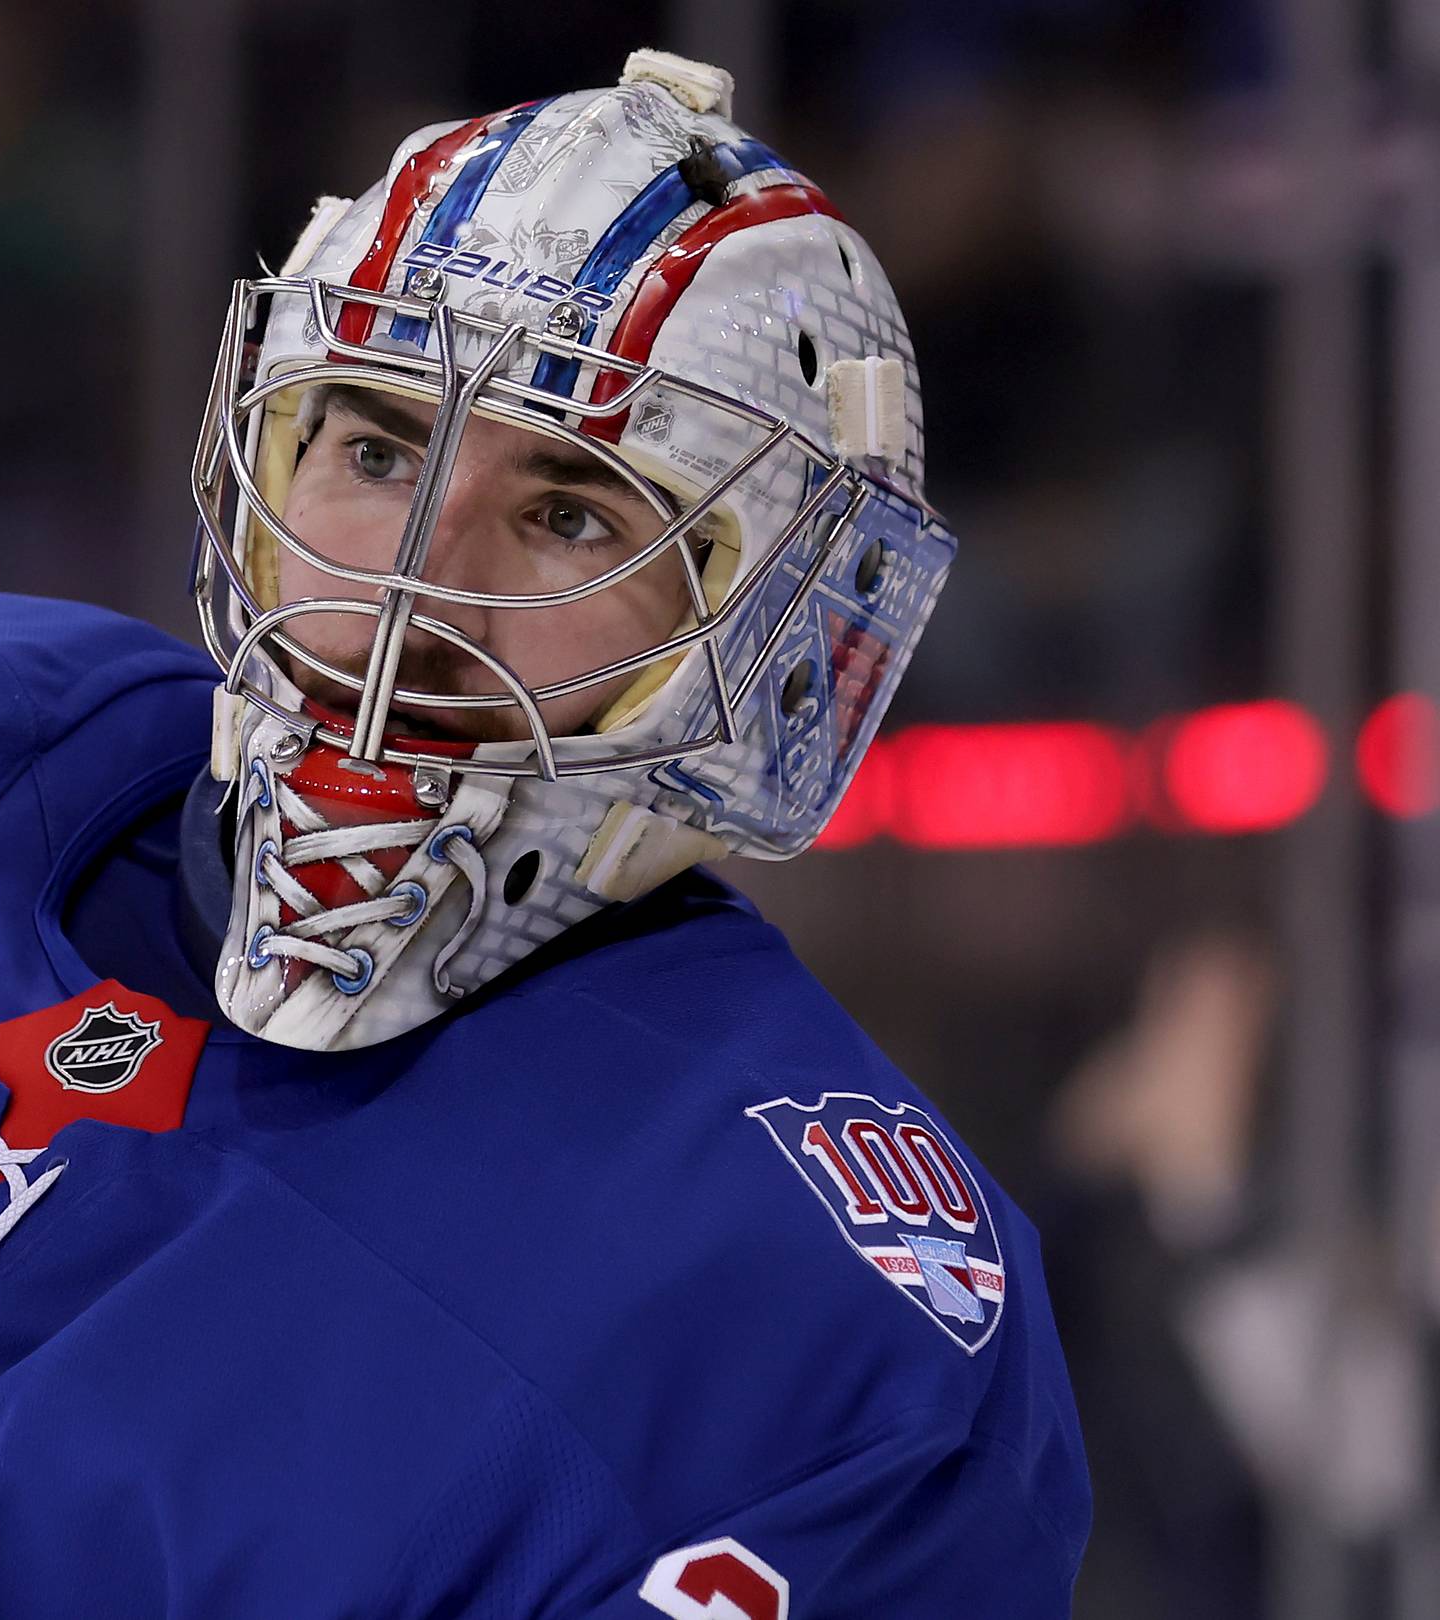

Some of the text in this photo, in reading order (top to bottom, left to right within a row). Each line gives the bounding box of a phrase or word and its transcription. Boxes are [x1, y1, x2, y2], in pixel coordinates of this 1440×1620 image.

[400, 241, 616, 323] BAUER
[640, 415, 668, 434] NHL
[62, 1038, 136, 1065] NHL
[800, 1118, 979, 1235] 100
[881, 1256, 917, 1273] 1926
[974, 1269, 1000, 1291] 2026
